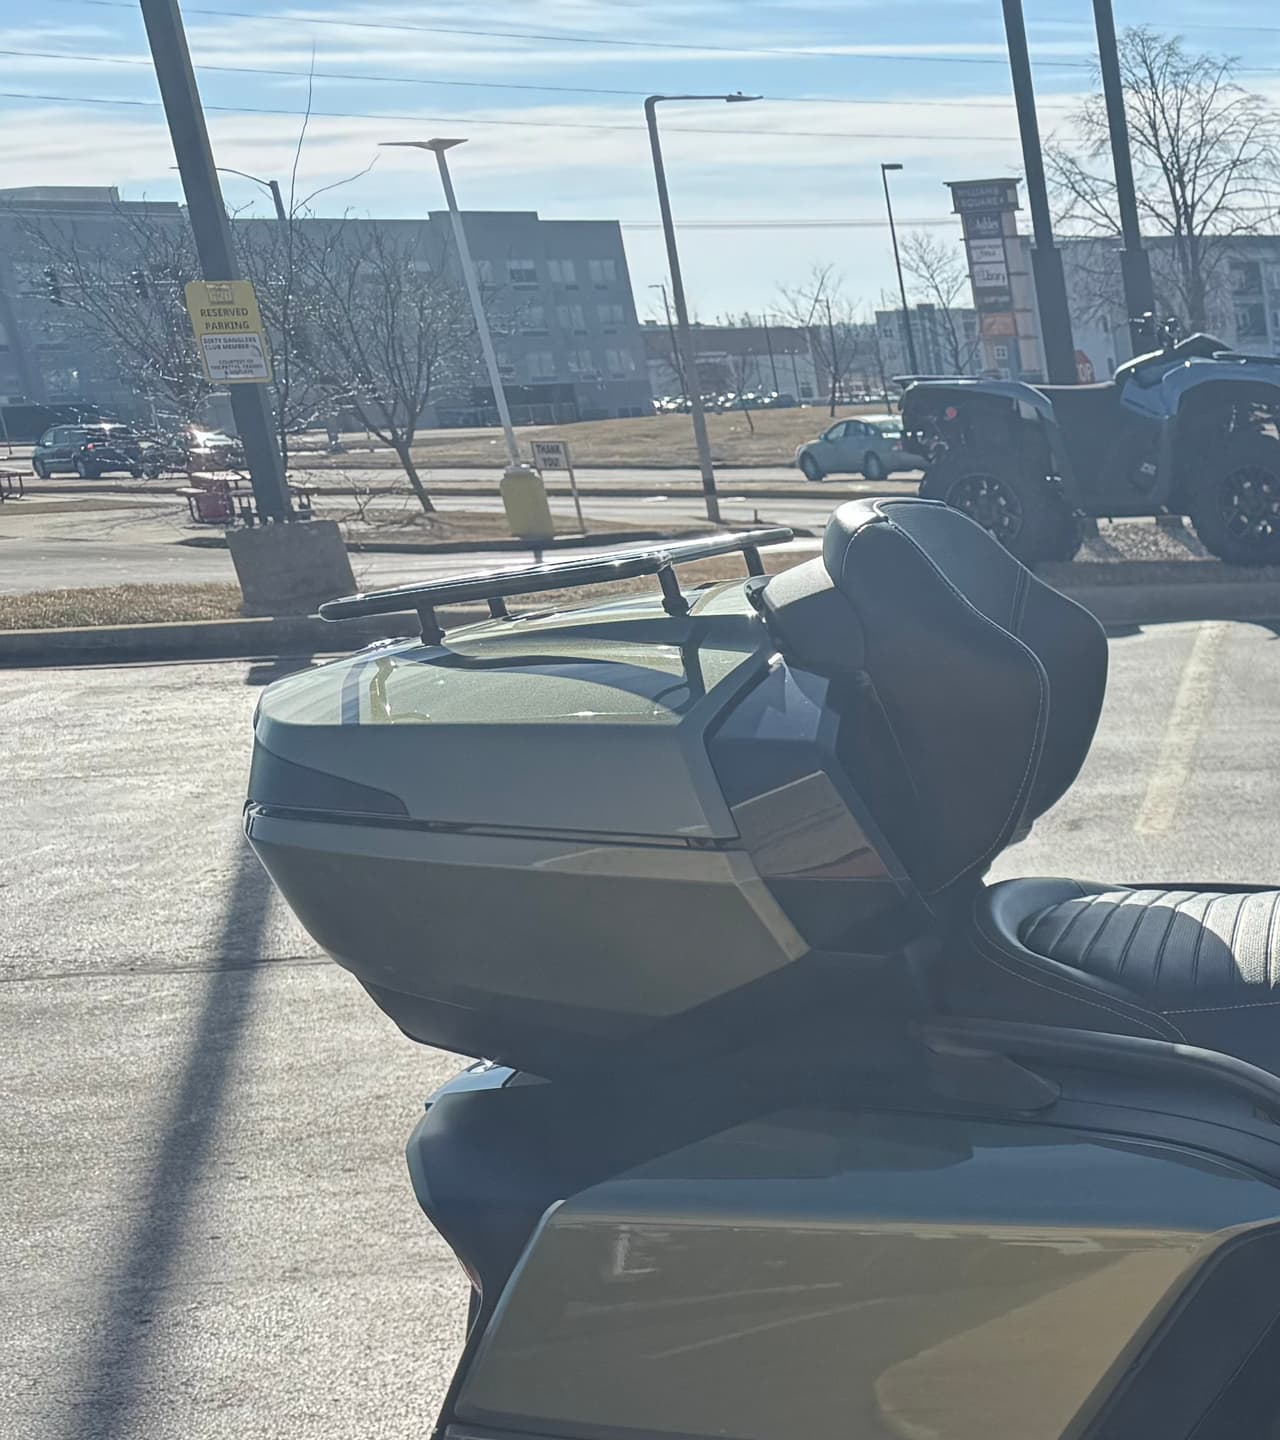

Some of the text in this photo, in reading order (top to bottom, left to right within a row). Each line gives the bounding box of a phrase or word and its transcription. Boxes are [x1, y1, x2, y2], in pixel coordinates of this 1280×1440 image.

[200, 307, 249, 318] RESERVED
[205, 320, 250, 331] PARKING
[536, 443, 562, 455] THANK
